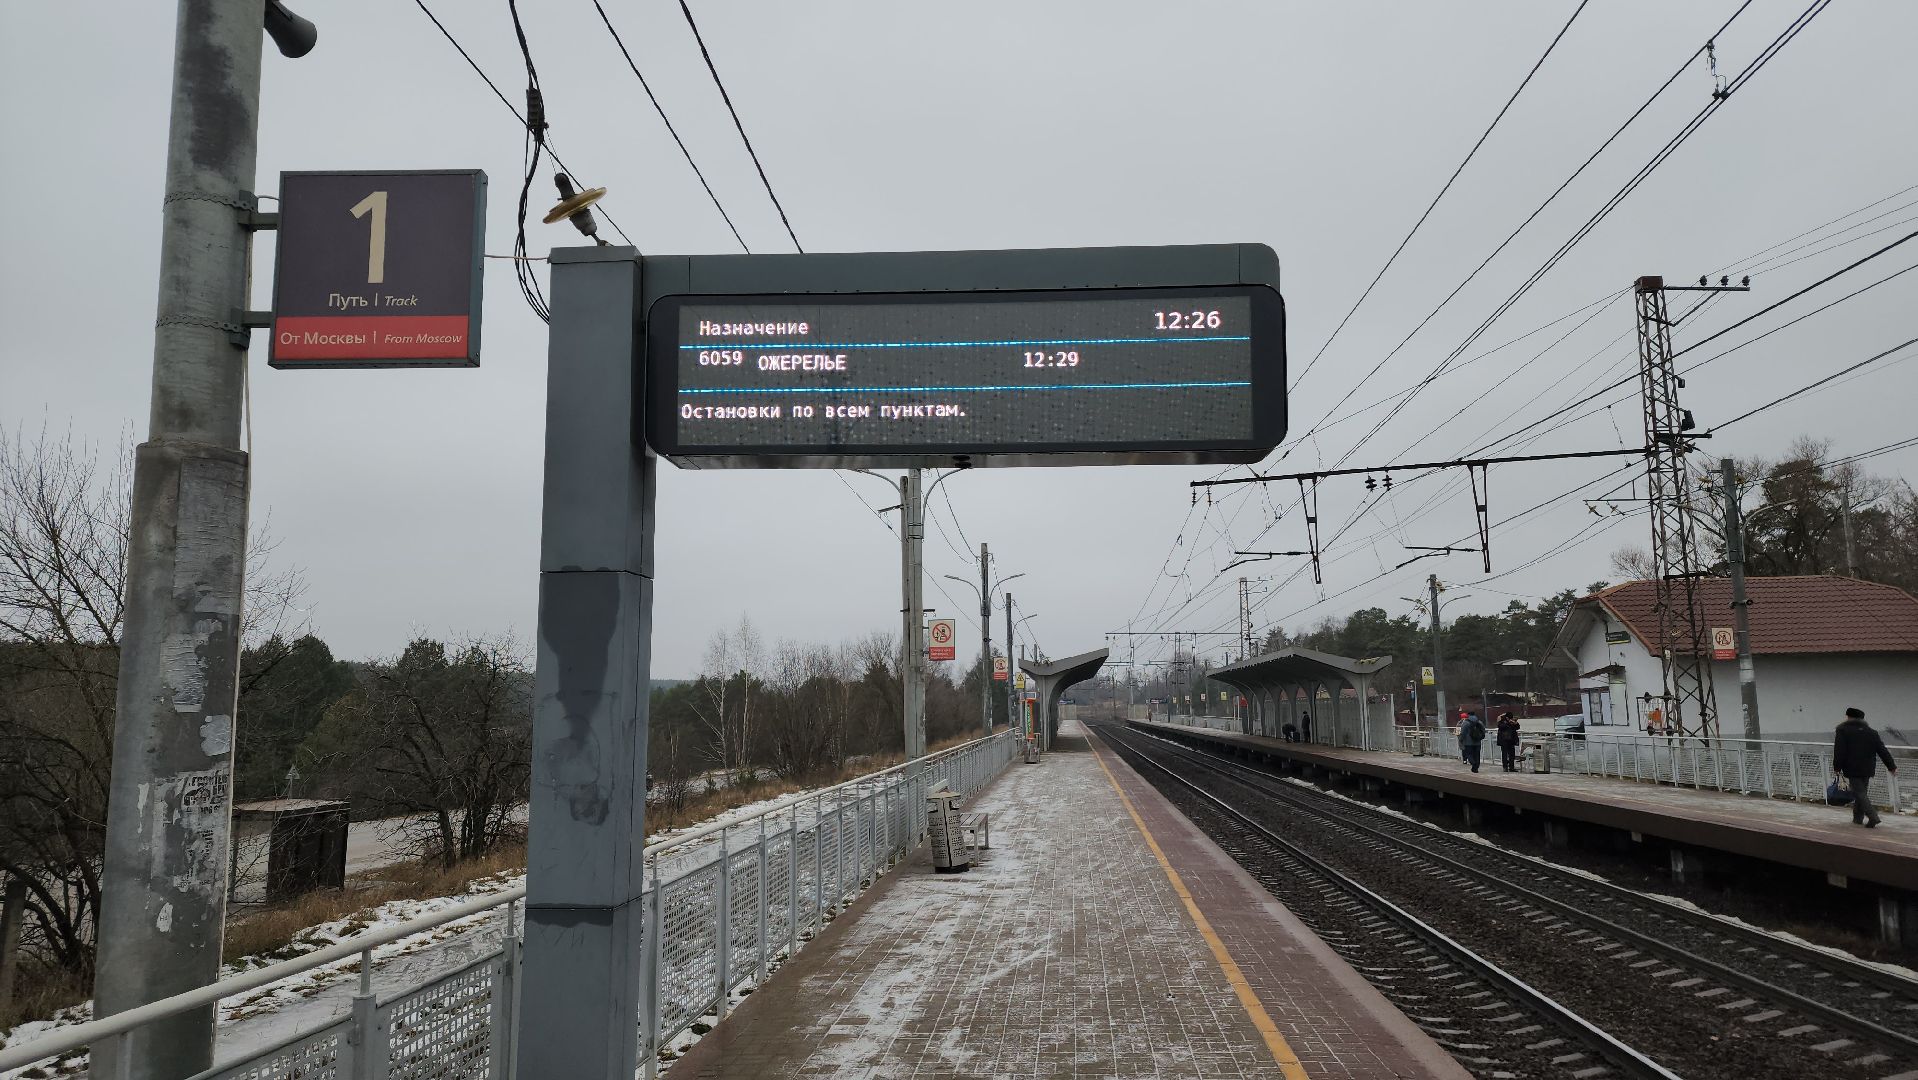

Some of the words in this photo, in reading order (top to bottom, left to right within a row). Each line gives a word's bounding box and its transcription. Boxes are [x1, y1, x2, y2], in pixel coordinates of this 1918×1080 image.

[350, 191, 388, 284] 1
[328, 293, 368, 311] Путь
[384, 294, 418, 307] Track
[699, 320, 809, 336] Назначение
[1154, 310, 1222, 330] 12:26
[280, 332, 301, 345] От
[304, 331, 366, 345] Москвы
[384, 333, 413, 344] From
[416, 332, 463, 344] Moscow
[699, 350, 743, 366] 6059
[758, 354, 847, 371] ОЖЕРЕЛЬЕ
[1023, 351, 1080, 367] 12:29
[681, 403, 781, 419] Остановки
[792, 406, 814, 418] по
[825, 405, 870, 418] всем
[880, 403, 966, 420] пунктам.
